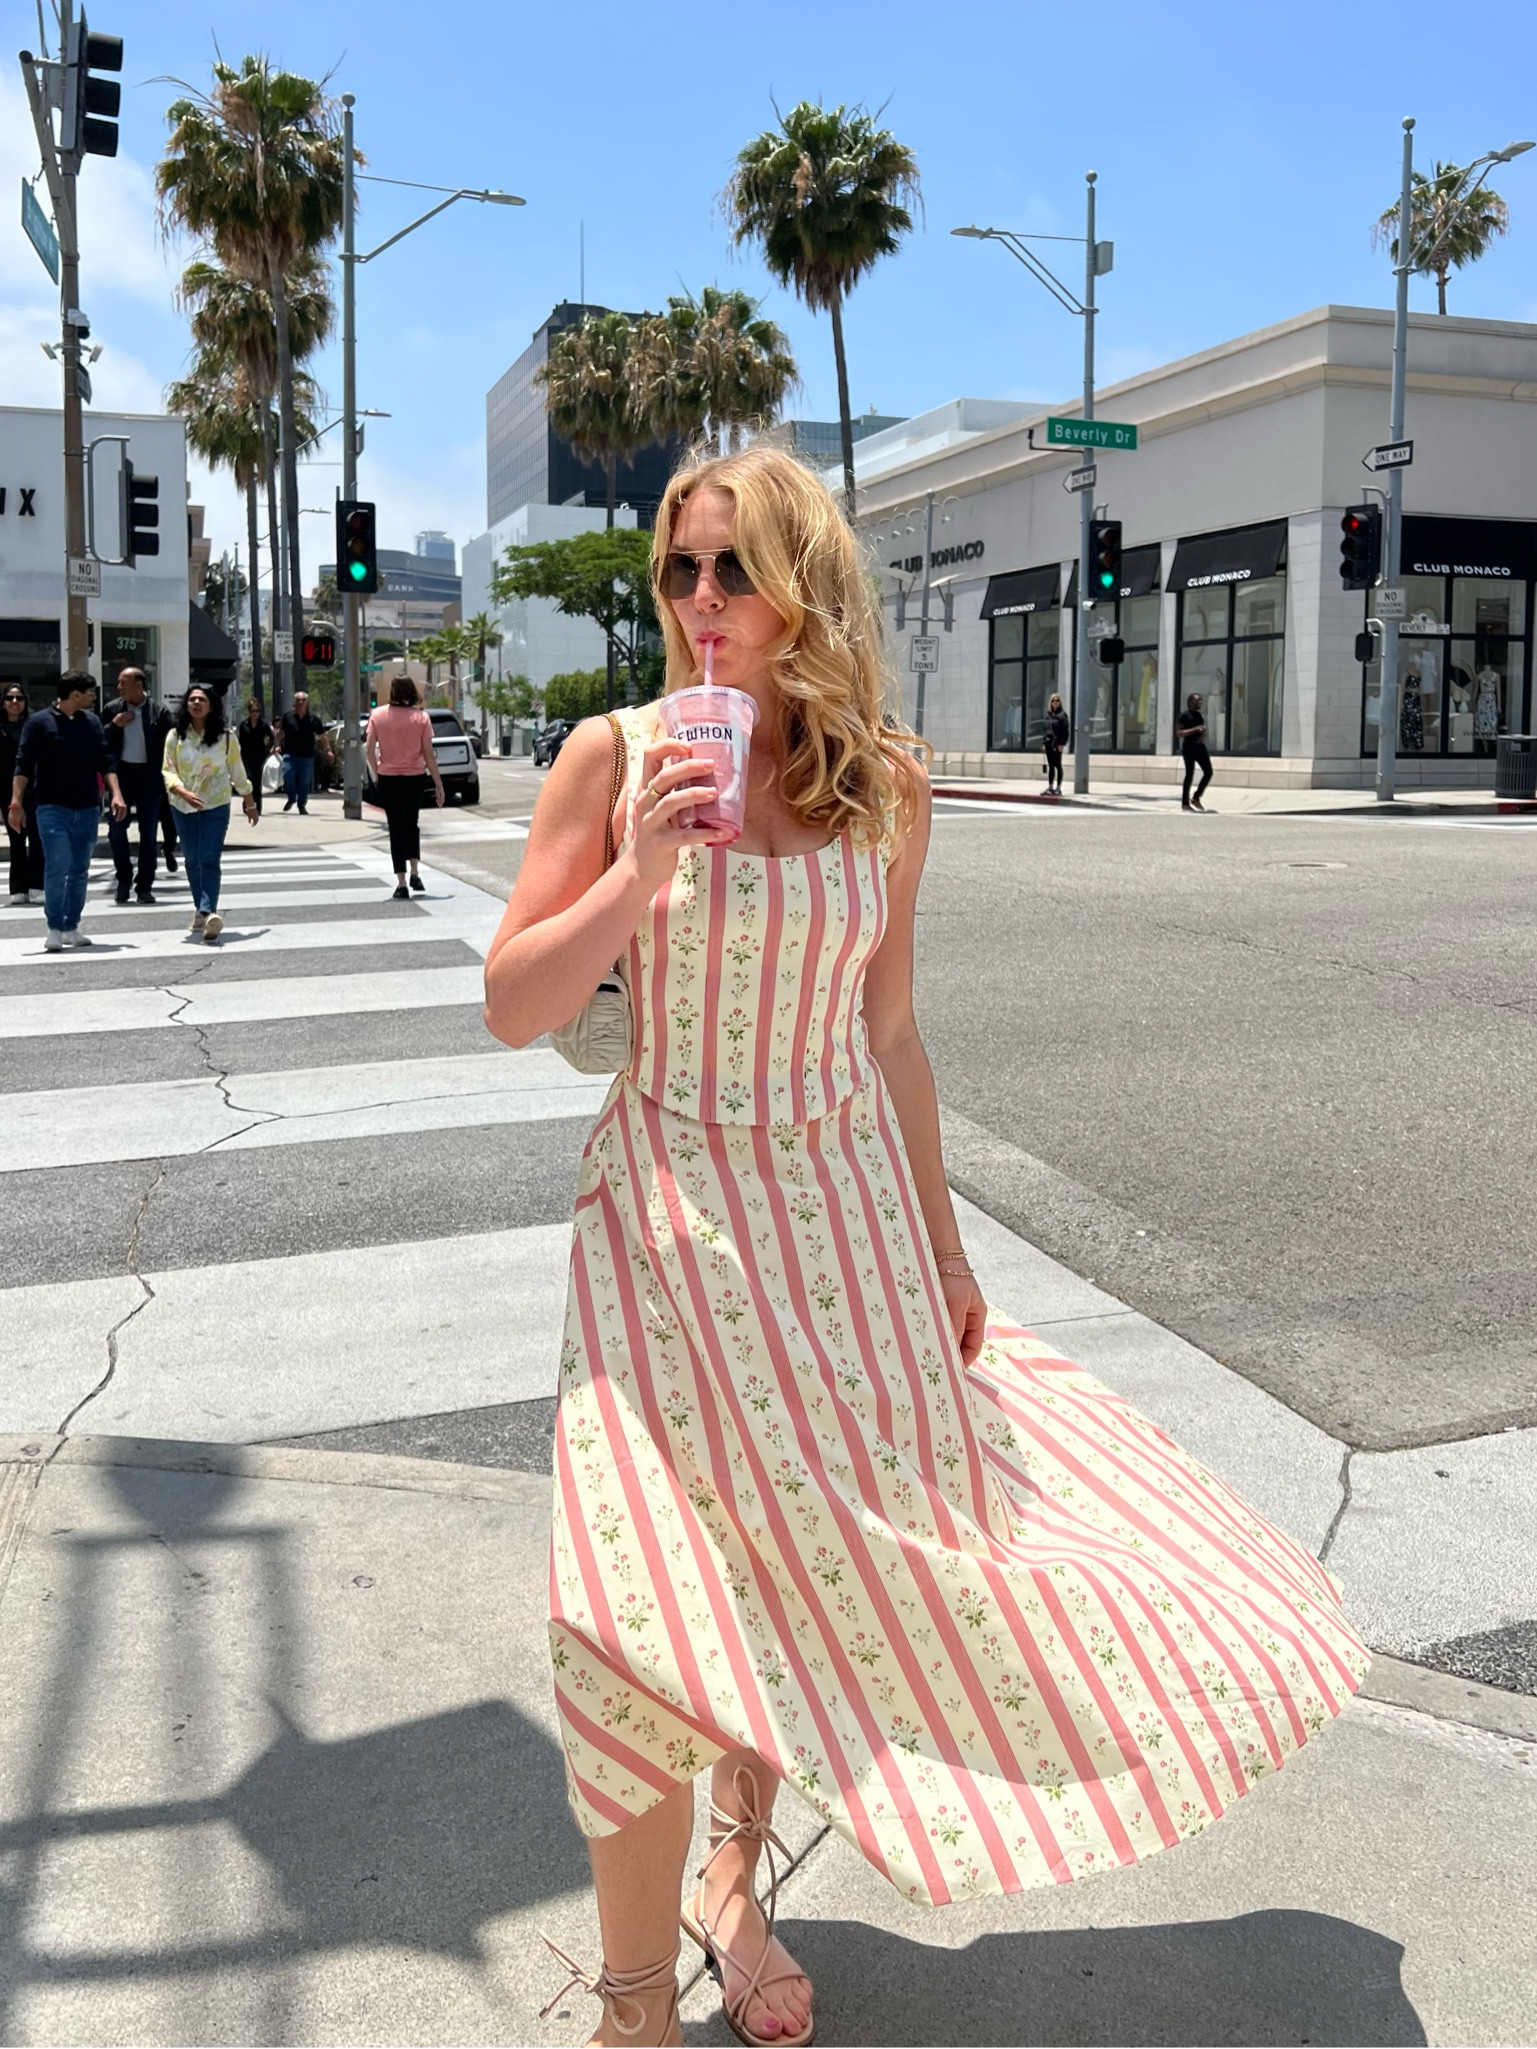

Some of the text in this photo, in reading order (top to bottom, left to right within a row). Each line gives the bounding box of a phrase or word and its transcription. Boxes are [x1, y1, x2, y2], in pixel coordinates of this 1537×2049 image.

[1055, 424, 1130, 445] Beverly Dr
[1375, 449, 1408, 464] ONE WAY
[78, 562, 91, 575] NO
[1413, 563, 1511, 576] CLUB MONACO
[1187, 569, 1251, 587] CLUB MONACO
[1384, 592, 1397, 601] NO
[117, 636, 136, 650] 375
[321, 644, 332, 660] 11
[921, 653, 928, 661] 5
